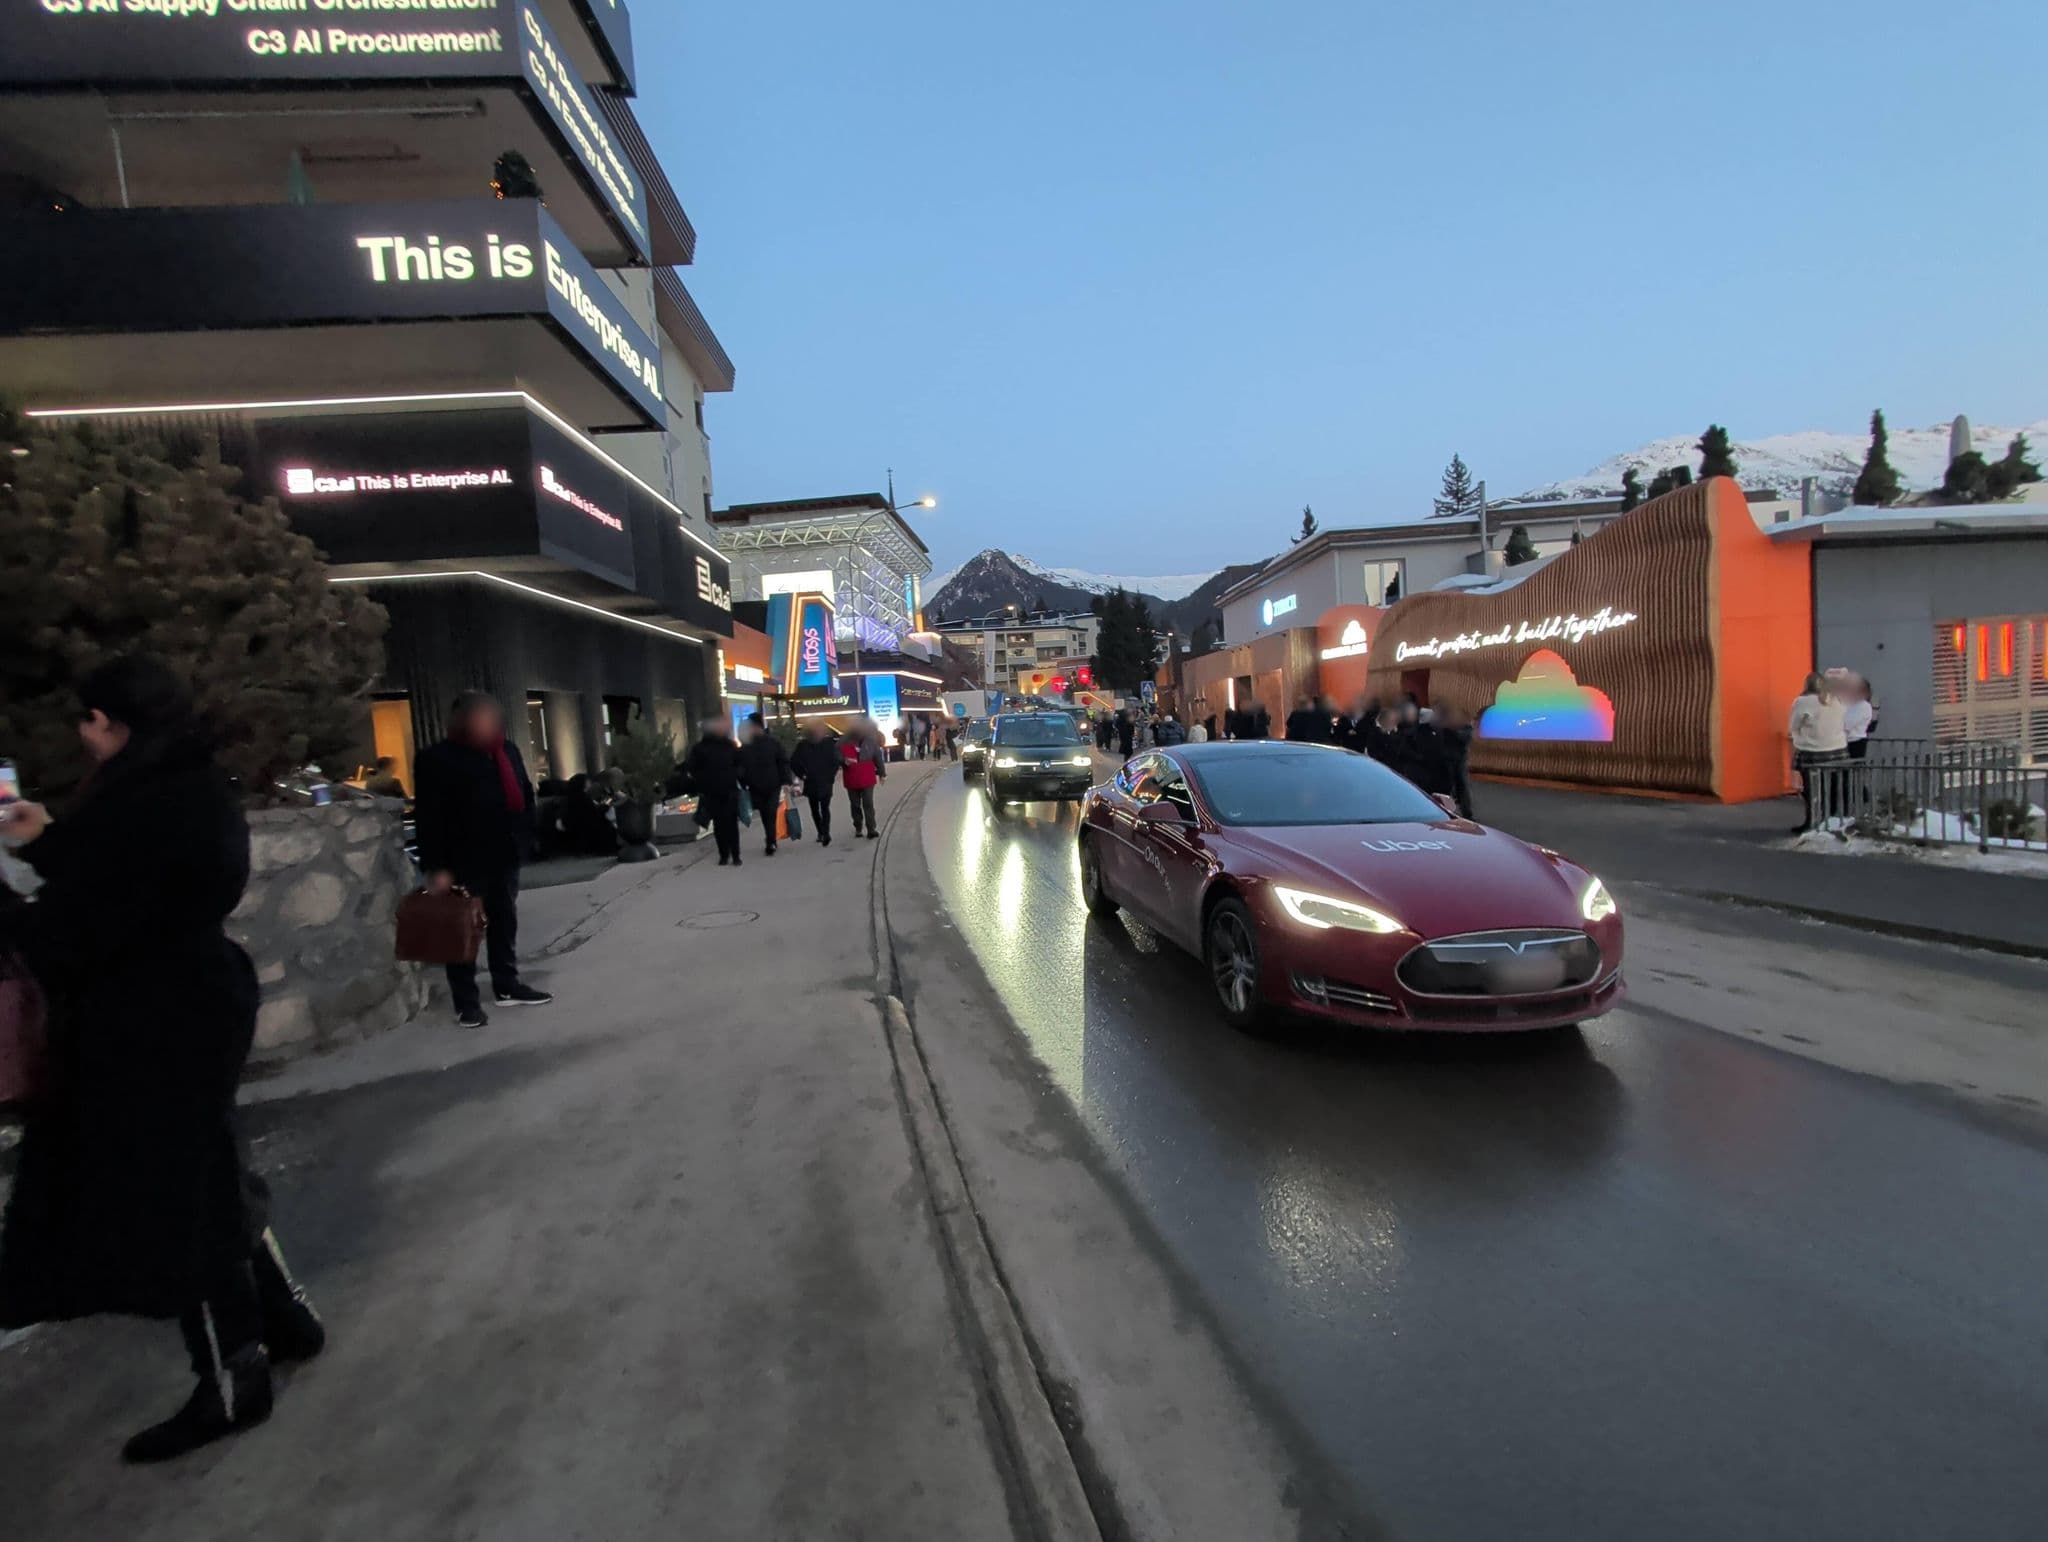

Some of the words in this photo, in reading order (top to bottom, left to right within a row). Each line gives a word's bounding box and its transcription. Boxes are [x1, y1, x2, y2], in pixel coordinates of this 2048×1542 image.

[246, 29, 288, 55] C3
[293, 28, 322, 54] AI
[328, 27, 503, 54] Procurement
[356, 235, 475, 282] This
[487, 234, 534, 279] is
[544, 239, 642, 378] Enterprise
[356, 475, 391, 490] This
[393, 474, 409, 489] is
[410, 471, 488, 490] Enterprise
[1482, 624, 1512, 646] and
[1514, 615, 1563, 643] build
[1563, 607, 1638, 643] together
[804, 627, 822, 673] Infosys
[1361, 840, 1453, 852] Uber
